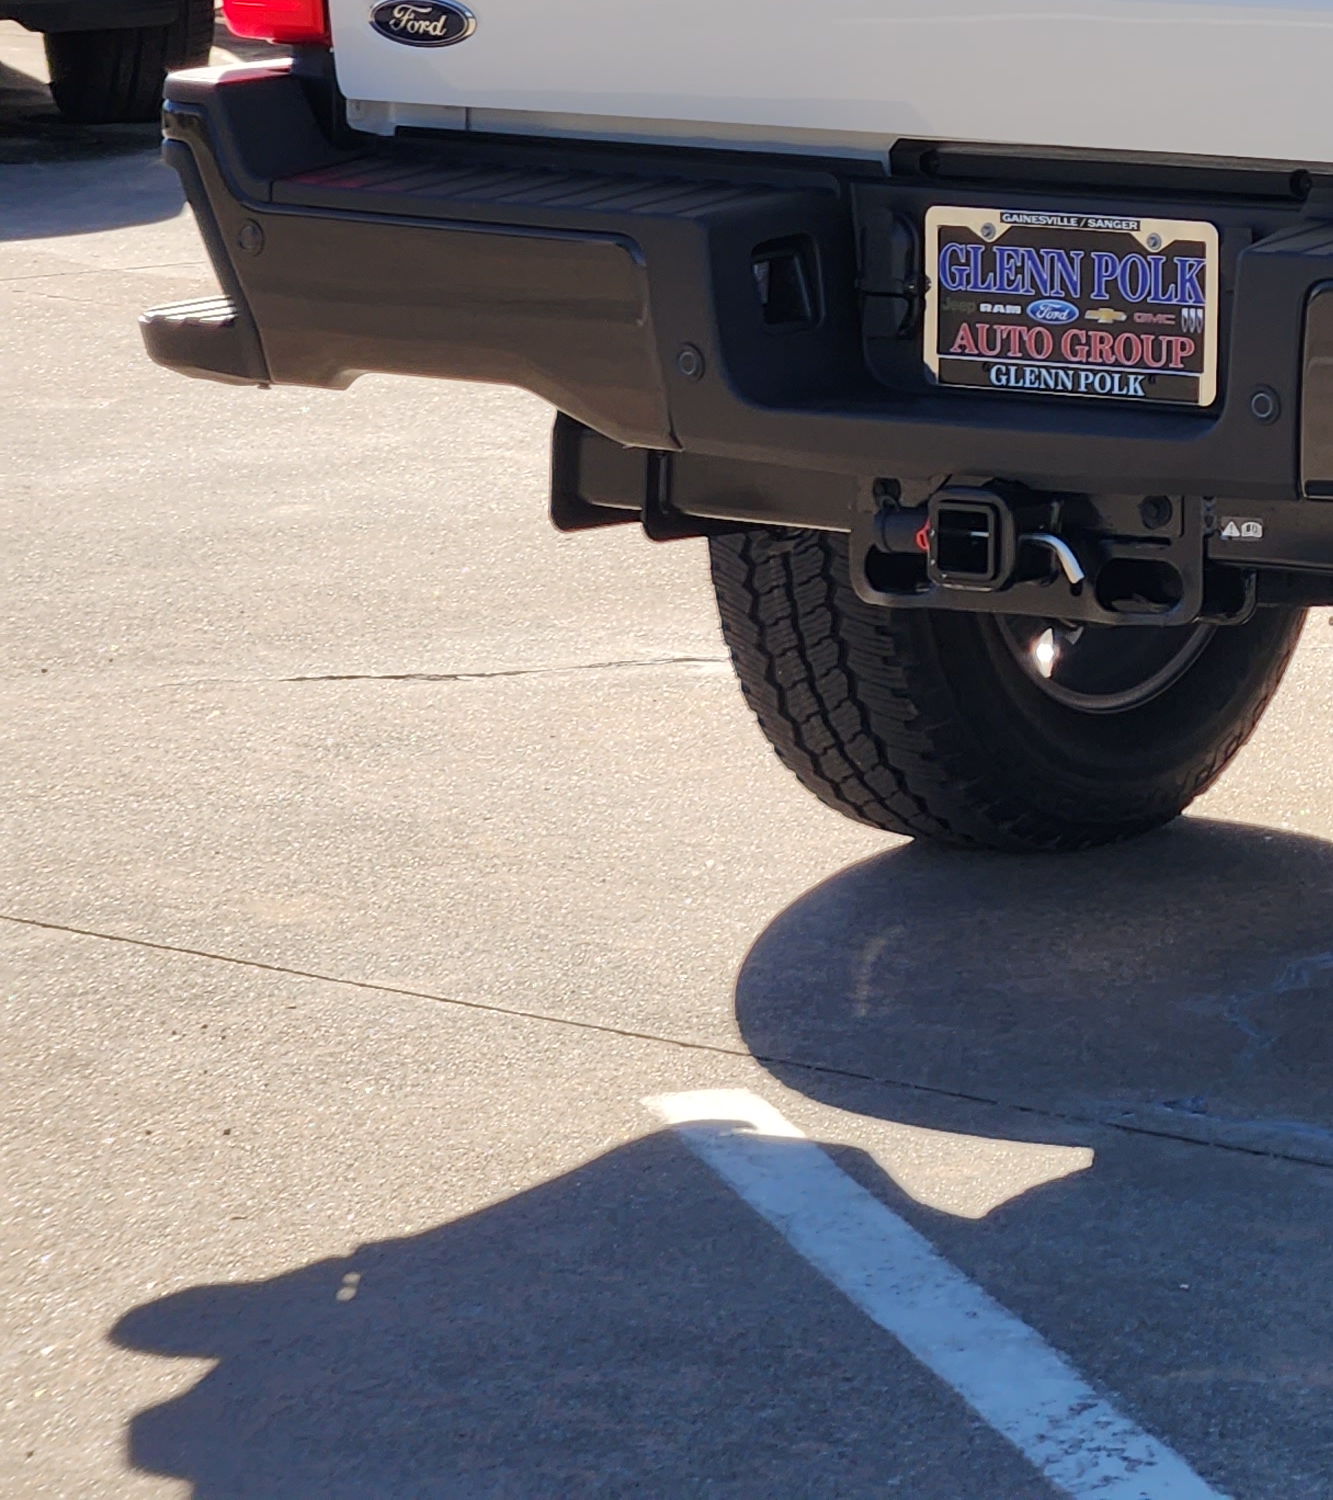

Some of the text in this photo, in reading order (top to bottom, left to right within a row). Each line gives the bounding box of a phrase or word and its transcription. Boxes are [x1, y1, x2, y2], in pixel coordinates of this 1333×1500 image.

[388, 3, 448, 36] Ford
[1001, 212, 1079, 228] GAINESVILLE
[1087, 218, 1139, 231] SANGER
[938, 242, 1206, 306] GLENN POLK
[942, 298, 1177, 326] Jeep RAM Ford GMC
[950, 322, 1196, 369] AUTO GROUP
[989, 364, 1146, 397] GLENN POLK
